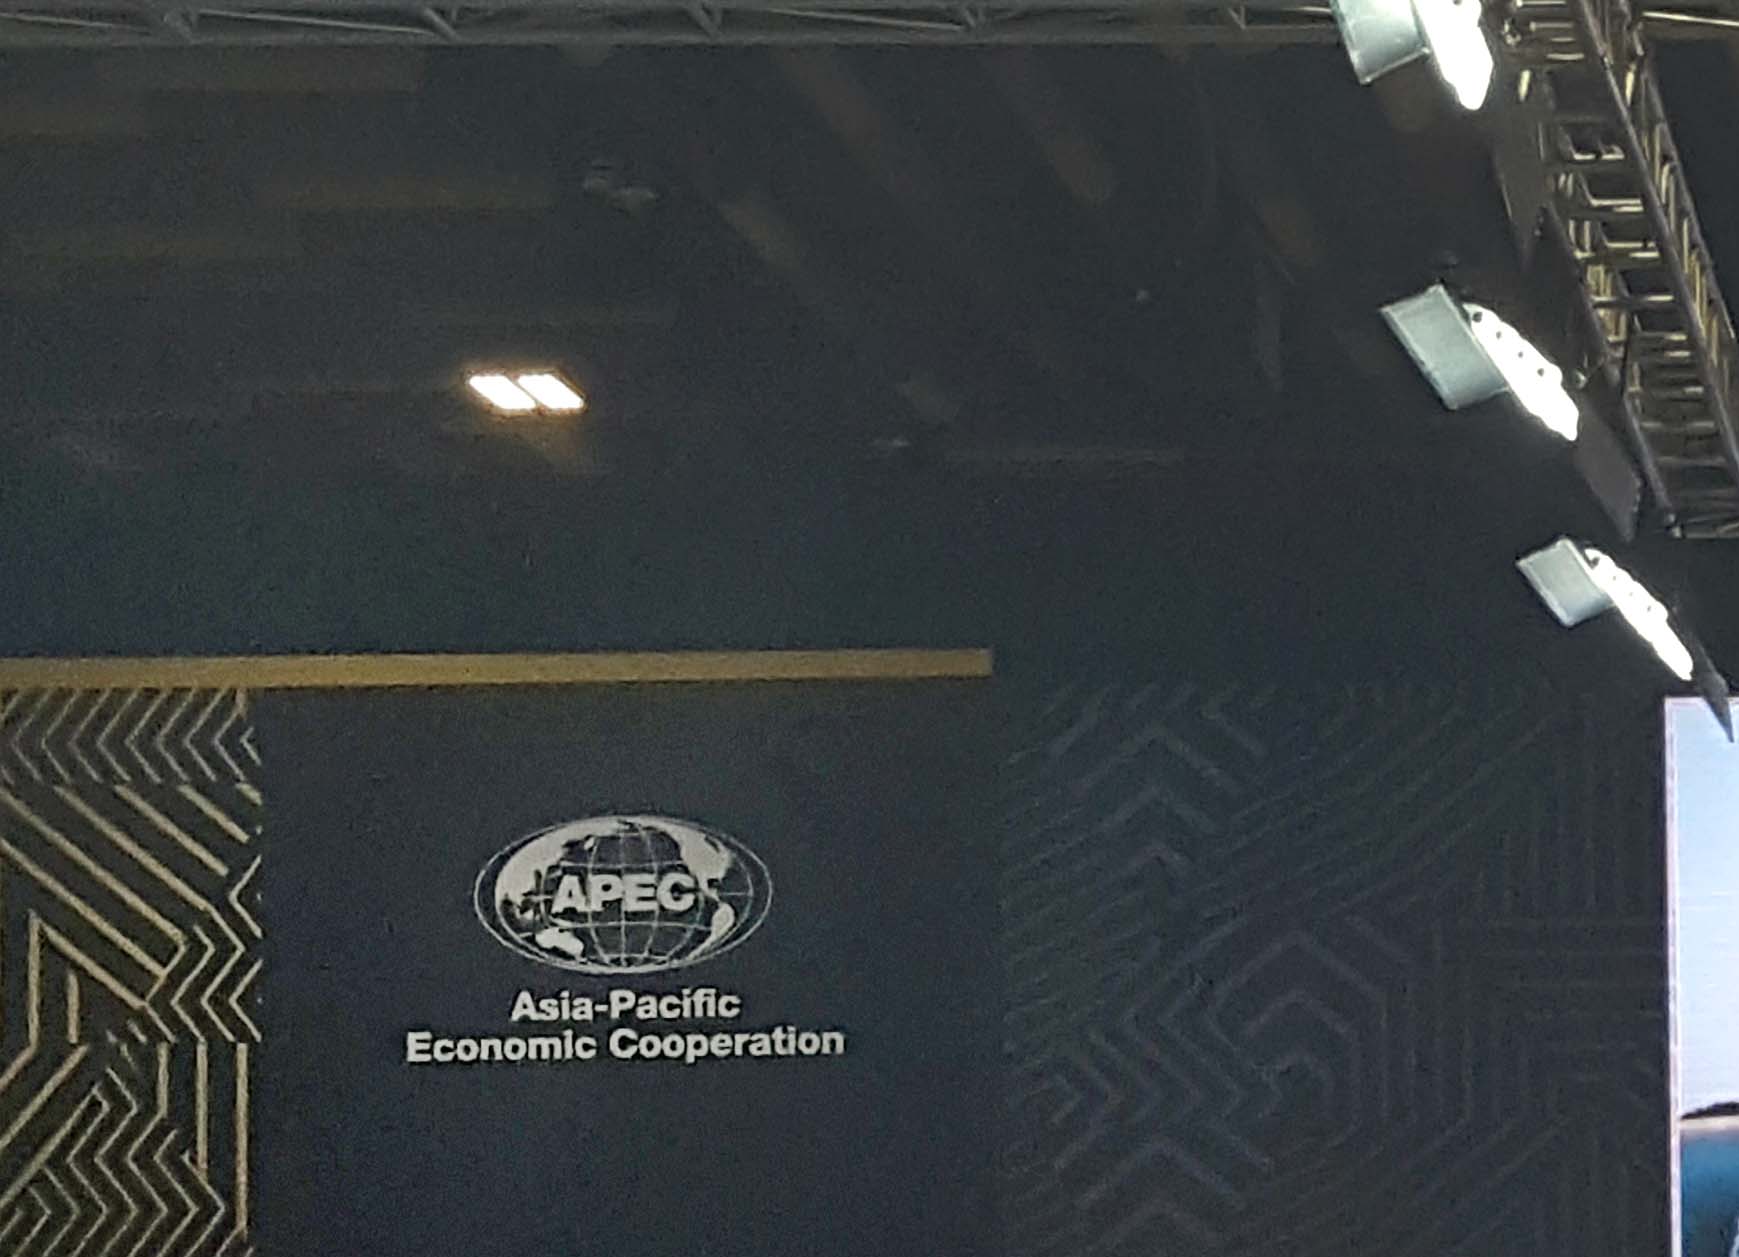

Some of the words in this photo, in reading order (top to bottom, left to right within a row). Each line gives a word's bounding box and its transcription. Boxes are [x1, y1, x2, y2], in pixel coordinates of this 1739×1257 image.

[551, 872, 695, 913] APEC
[510, 989, 741, 1022] Asia-Pacific
[406, 1031, 597, 1063] Economic
[609, 1027, 845, 1063] Cooperation
